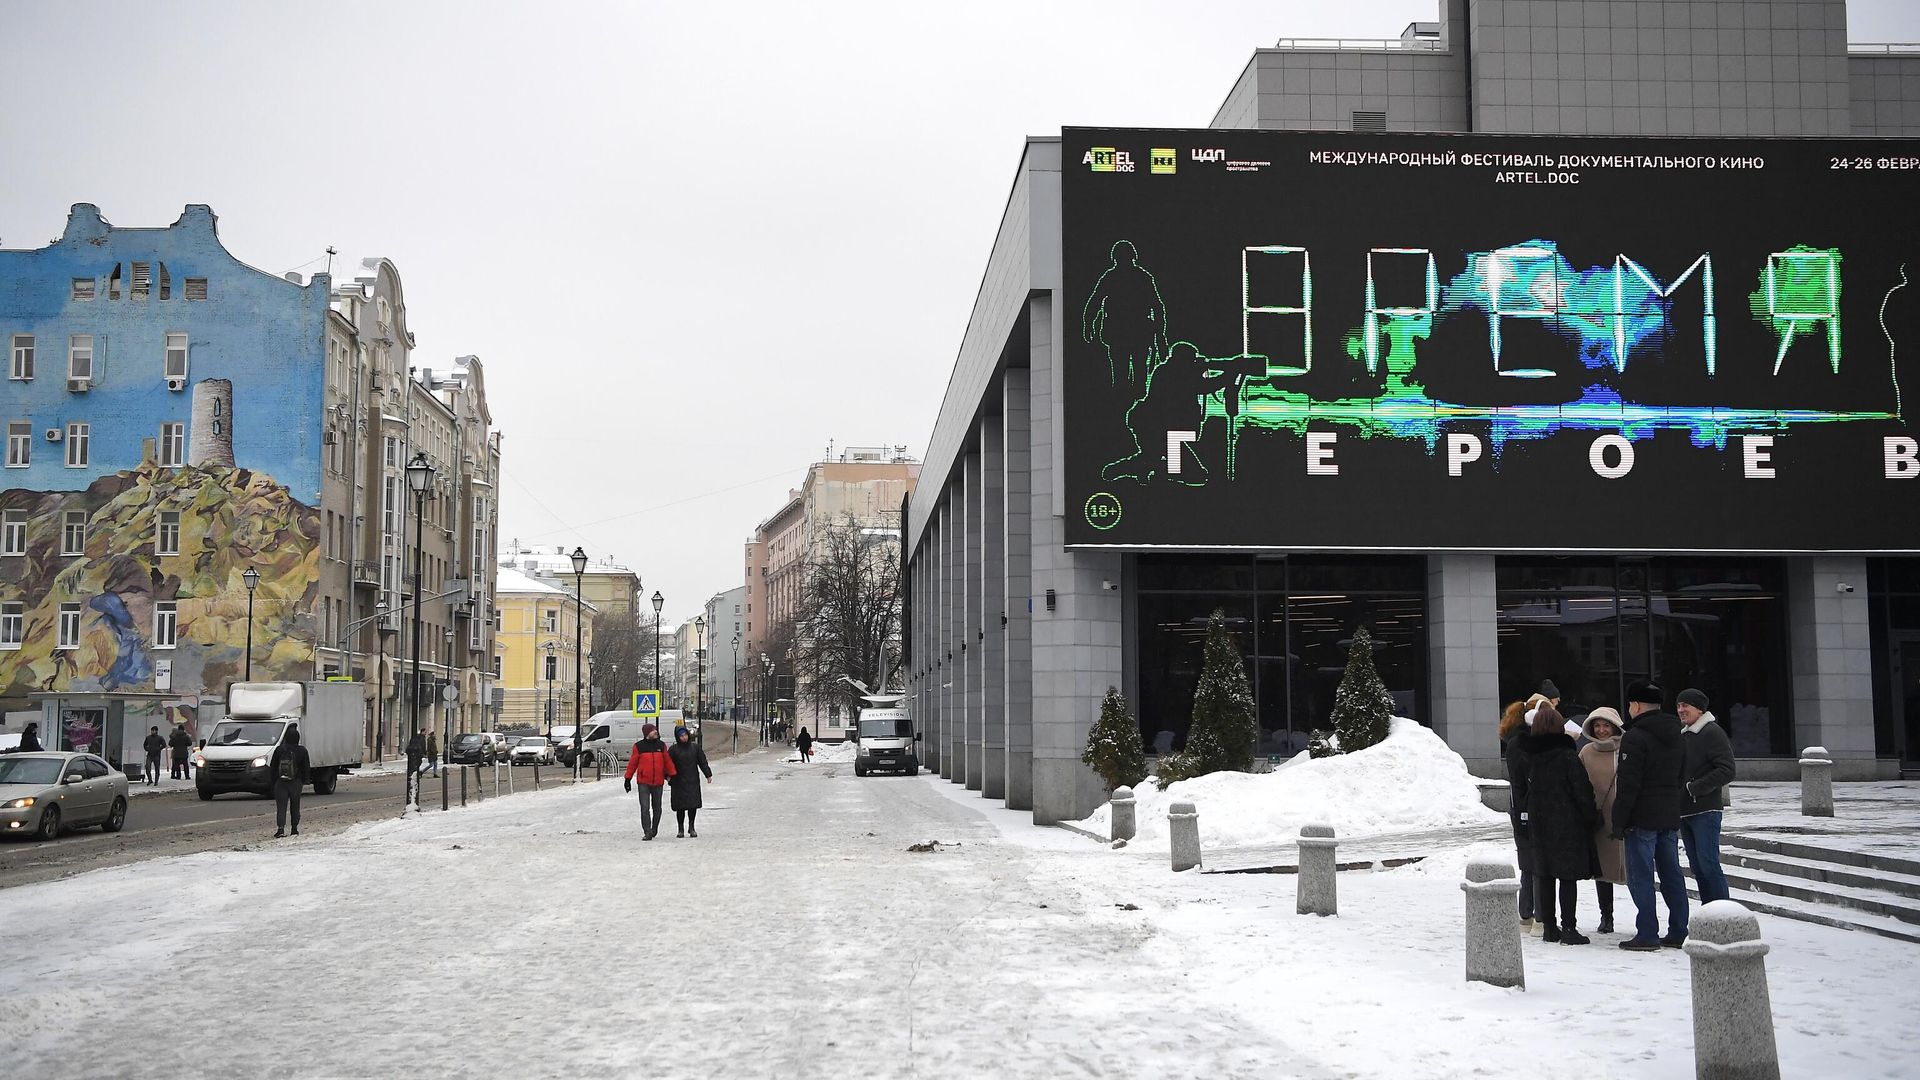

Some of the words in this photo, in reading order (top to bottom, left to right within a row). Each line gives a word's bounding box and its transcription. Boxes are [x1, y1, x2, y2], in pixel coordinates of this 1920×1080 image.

[1082, 151, 1134, 165] ARTEL
[1191, 148, 1225, 163] ЦДП
[1309, 150, 1456, 167] МЕЖДУНАРОДНЫЙ
[1460, 153, 1555, 168] ФЕСТИВАЛЬ
[1557, 155, 1716, 171] ДОКУМЕНТАЛЬНОГО
[1720, 156, 1765, 169] КИНО
[1115, 164, 1135, 173] DOC
[1830, 157, 1873, 170] 24-26
[1877, 156, 1920, 170] ФЕВР
[1495, 171, 1580, 184] ARTEL.DOC
[1166, 430, 1920, 479] ГЕРОЕВ
[1090, 504, 1118, 518] 18+
